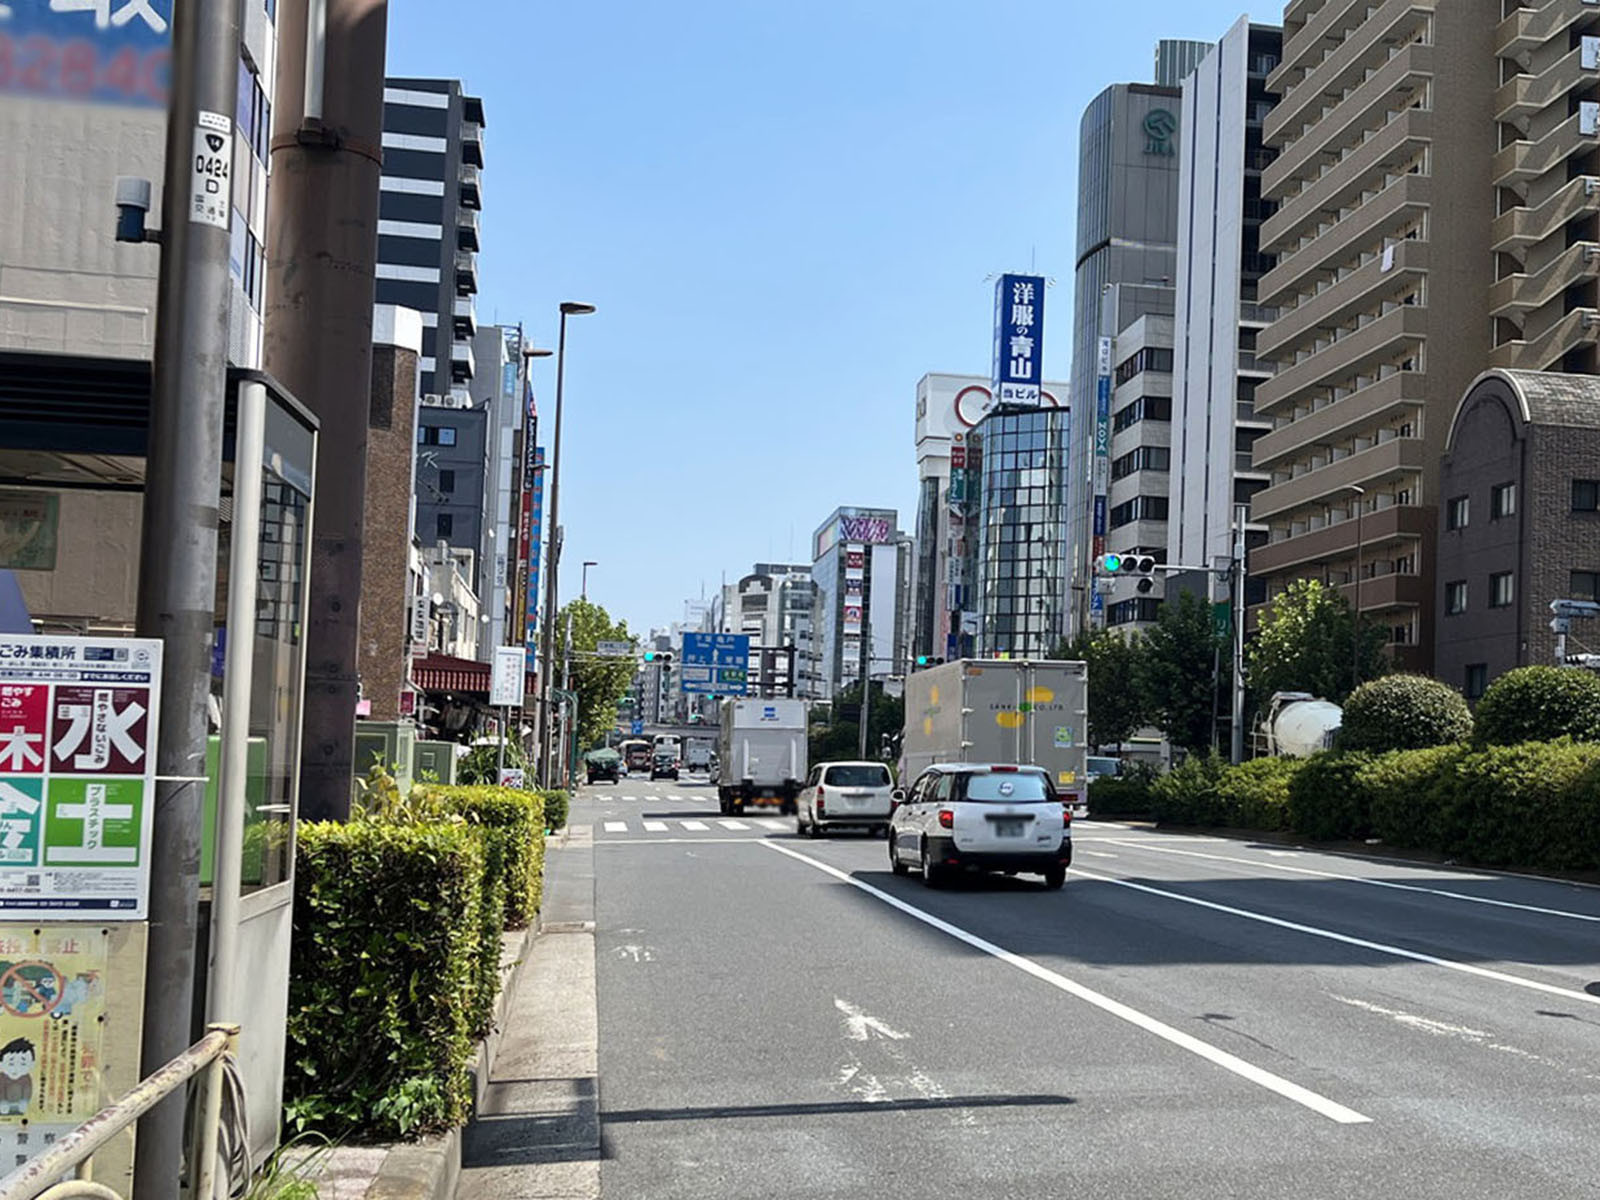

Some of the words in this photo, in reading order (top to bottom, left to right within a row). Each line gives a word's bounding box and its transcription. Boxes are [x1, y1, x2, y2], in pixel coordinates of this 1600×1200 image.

[1009, 282, 1035, 380] 洋服の青山
[1003, 388, 1038, 400] 当ビル
[1098, 422, 1107, 452] NOVA
[1, 697, 22, 709] ごみ
[53, 689, 147, 770] 水
[46, 783, 137, 862] 土
[87, 786, 102, 850] プラスチック
